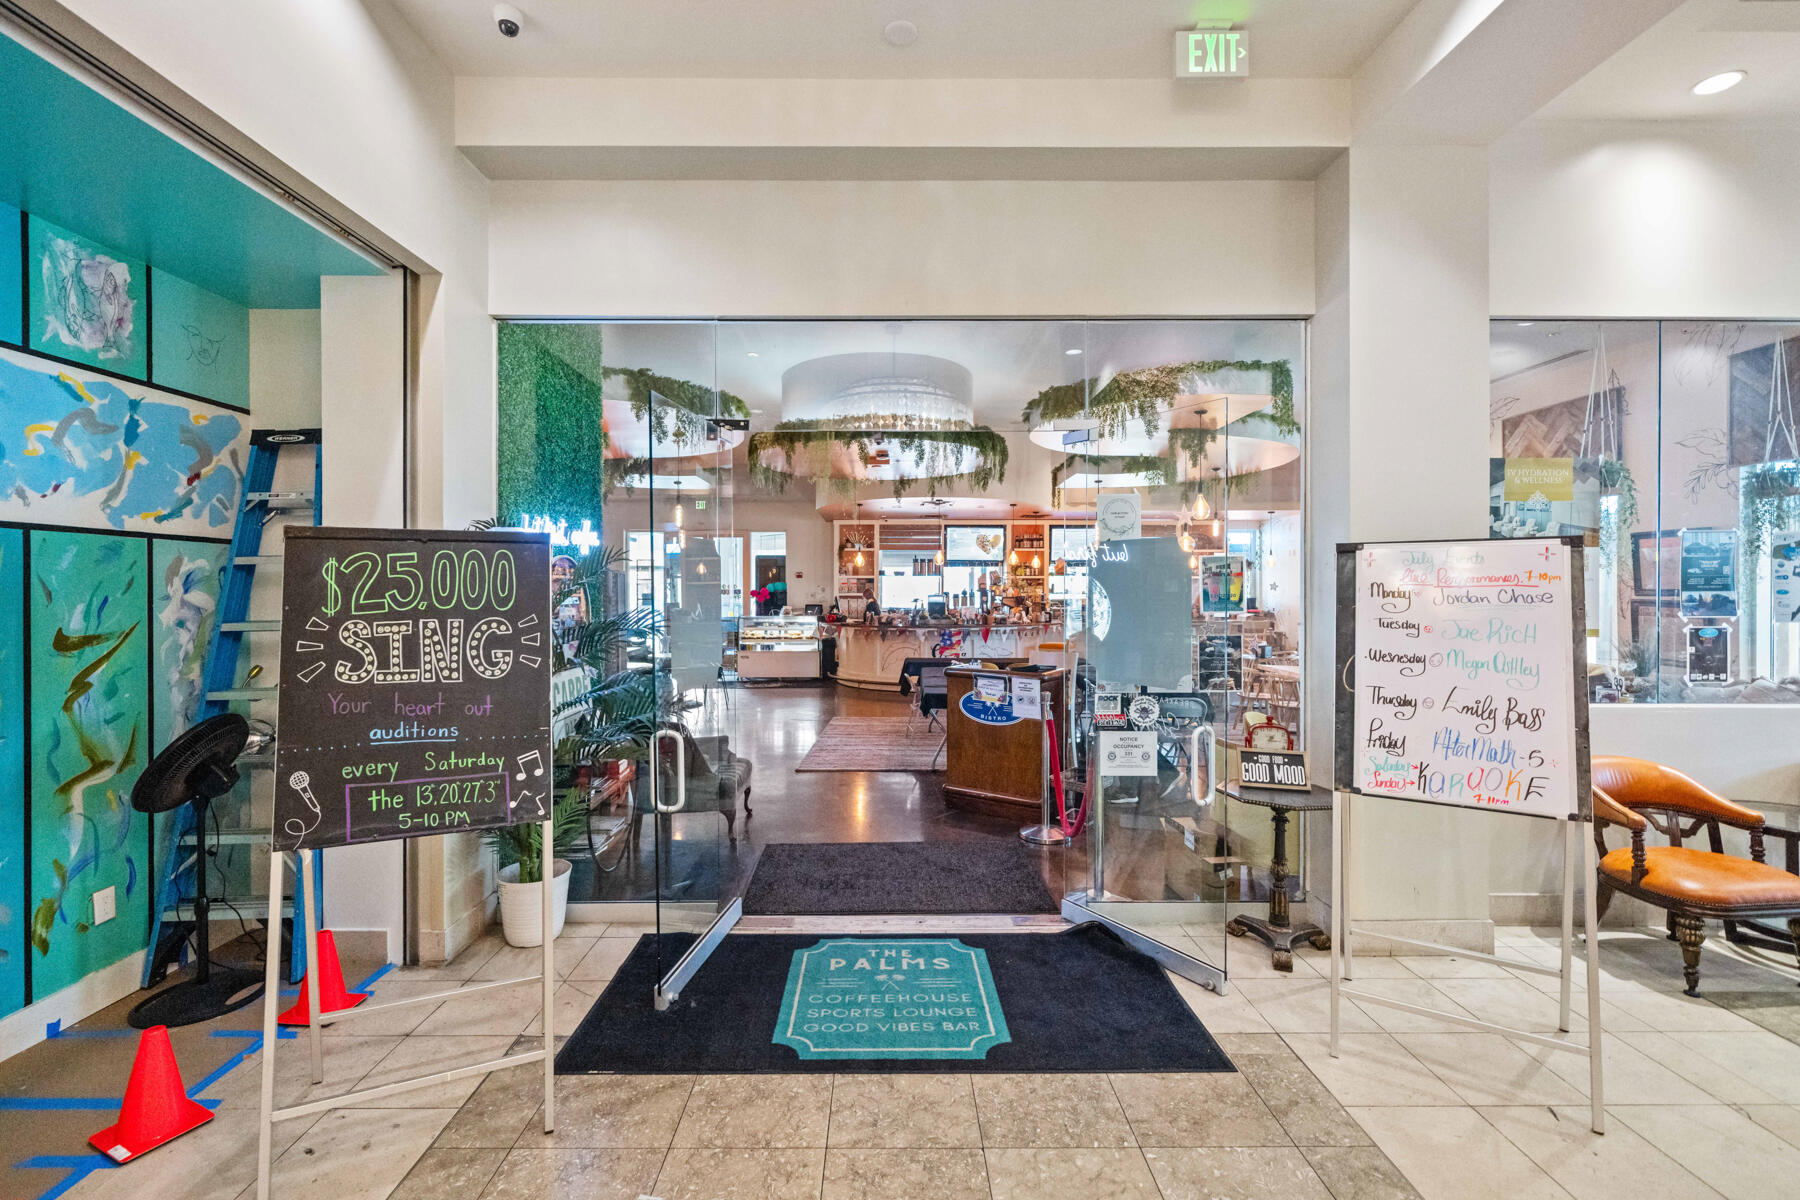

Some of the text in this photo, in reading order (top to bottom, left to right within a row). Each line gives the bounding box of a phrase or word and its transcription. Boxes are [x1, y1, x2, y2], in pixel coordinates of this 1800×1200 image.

[1188, 33, 1240, 72] EXIT
[1517, 468, 1569, 477] HYDRATION
[1521, 476, 1564, 484] WELLNESS
[1370, 581, 1554, 613] Monday Jordan Chase
[1373, 617, 1420, 639] Tuesday
[334, 617, 513, 684] SING
[328, 692, 494, 716] Your heart out
[1365, 685, 1418, 721] Thursday
[1441, 686, 1498, 735] Emily
[980, 713, 1007, 721] BISTRO
[369, 721, 459, 740] auditions
[1366, 717, 1407, 758] Friday
[342, 751, 505, 783] every Saturday
[1258, 754, 1283, 764] GOOD FOOD
[1242, 762, 1306, 785] GOOD MOOD
[1367, 770, 1407, 793] Sunday
[368, 788, 404, 812] the
[445, 810, 471, 826] PM
[868, 949, 912, 957] THE
[830, 958, 950, 971] PALMS
[808, 993, 973, 1004] COFFEEHOUSE
[807, 1007, 977, 1018] SPORTS LOUNGE
[803, 1021, 980, 1033] GOOD VIBES BAR
